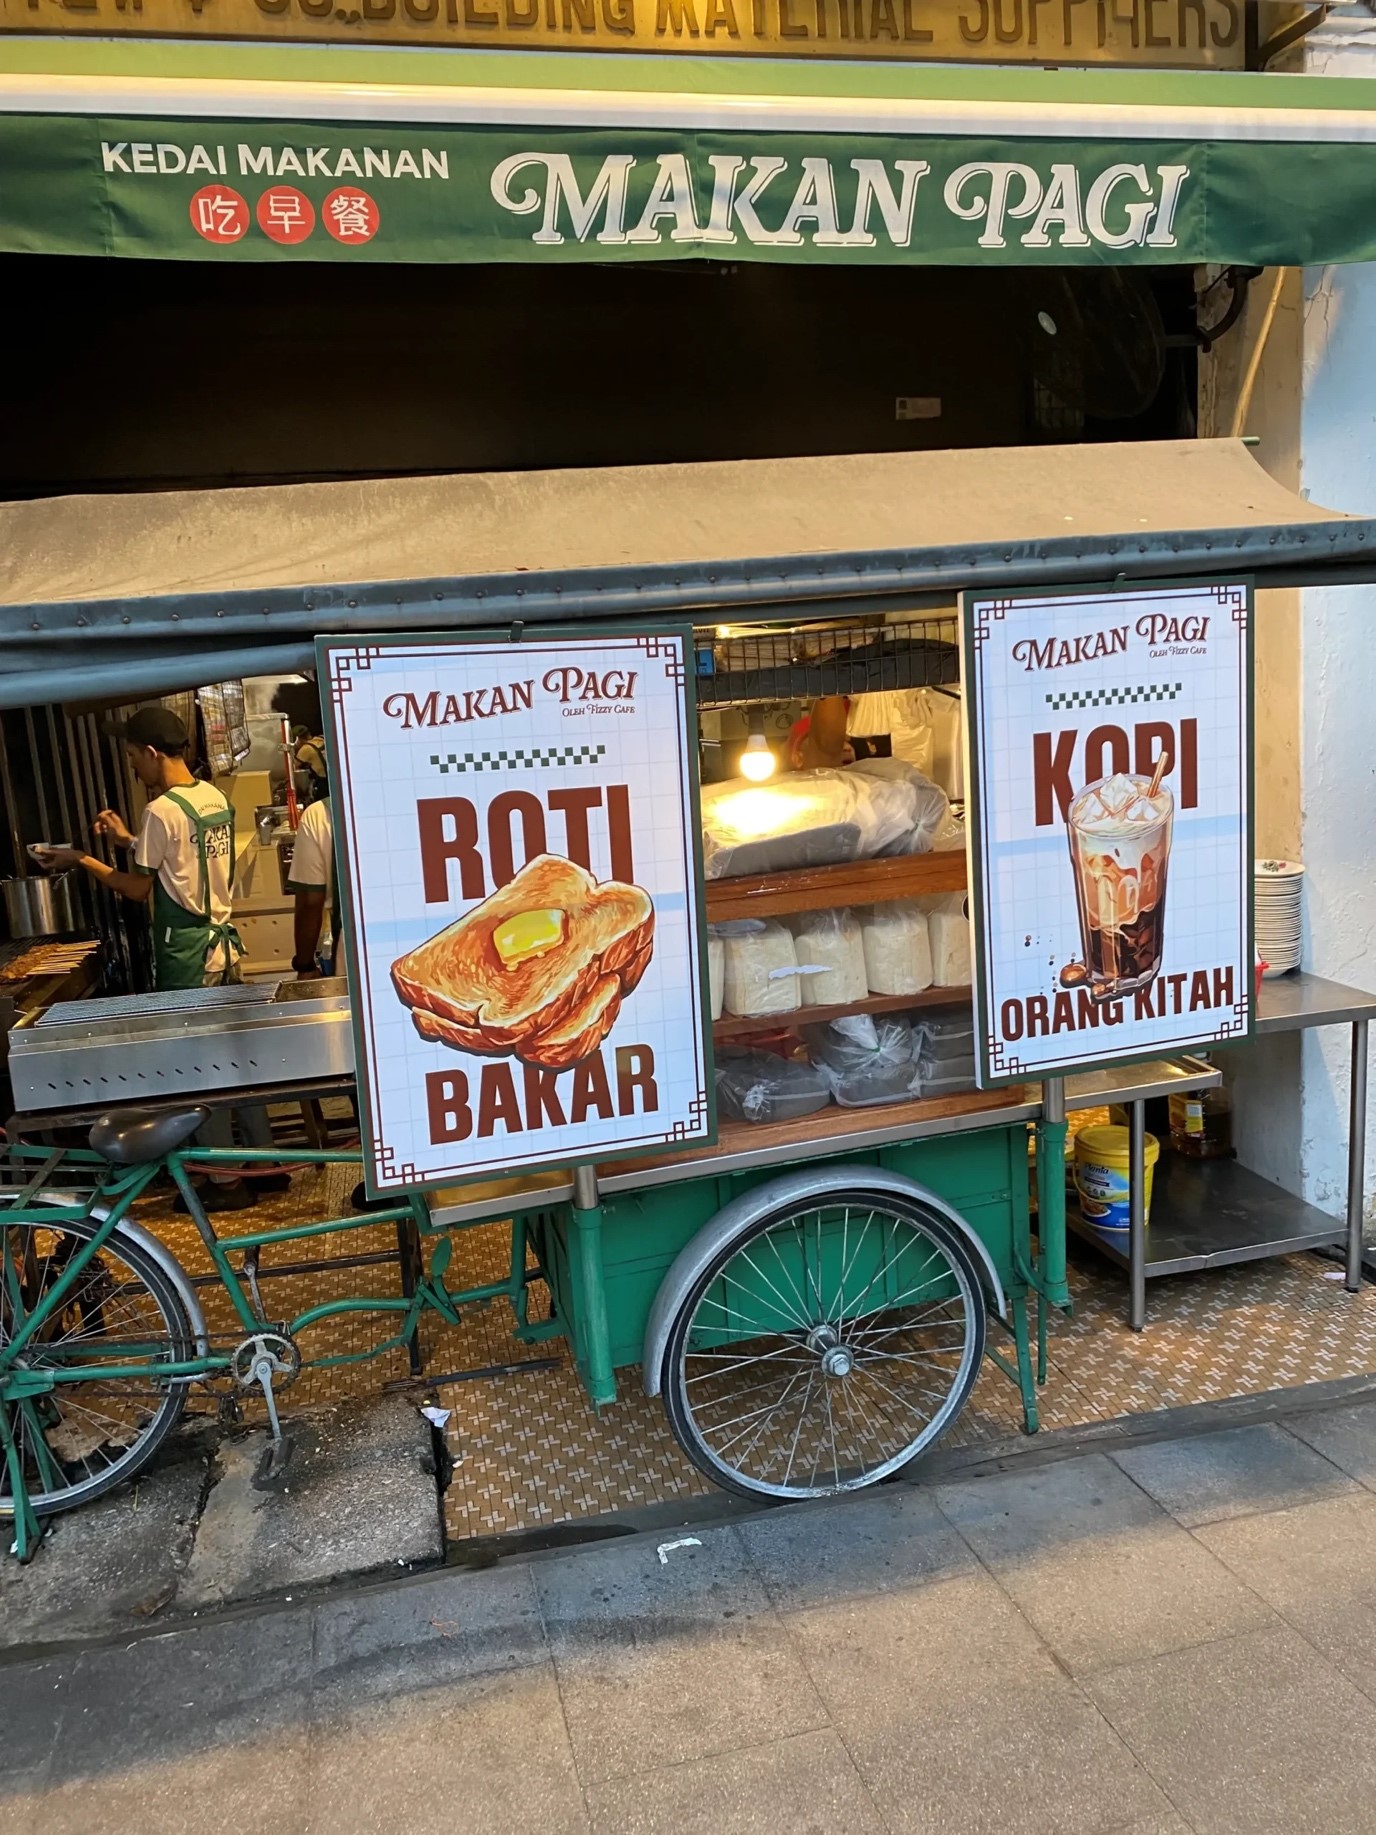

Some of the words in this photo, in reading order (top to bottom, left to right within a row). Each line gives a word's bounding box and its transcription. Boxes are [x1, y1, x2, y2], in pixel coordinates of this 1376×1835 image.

[101, 142, 227, 175] KEDAI
[238, 144, 449, 179] MAKANAN
[198, 194, 371, 237] 吃早餐
[490, 151, 930, 247] MAKAN
[944, 161, 1190, 249] PAGI
[1012, 625, 1130, 671] MAKAN
[1135, 613, 1211, 645] PAGI
[1168, 646, 1189, 655] FIZZY
[1190, 646, 1207, 655] CAFE
[382, 680, 535, 730] MAKAN
[542, 666, 639, 703] PAGI
[562, 707, 585, 718] OLEH
[586, 703, 613, 714] FIZZY
[614, 704, 635, 714] CAFE
[1033, 718, 1198, 827] KOPI
[416, 784, 635, 904] ROTI
[1001, 989, 1124, 1042] ORANG
[1133, 966, 1234, 1021] KITAH
[424, 1043, 659, 1146] BAKAR
